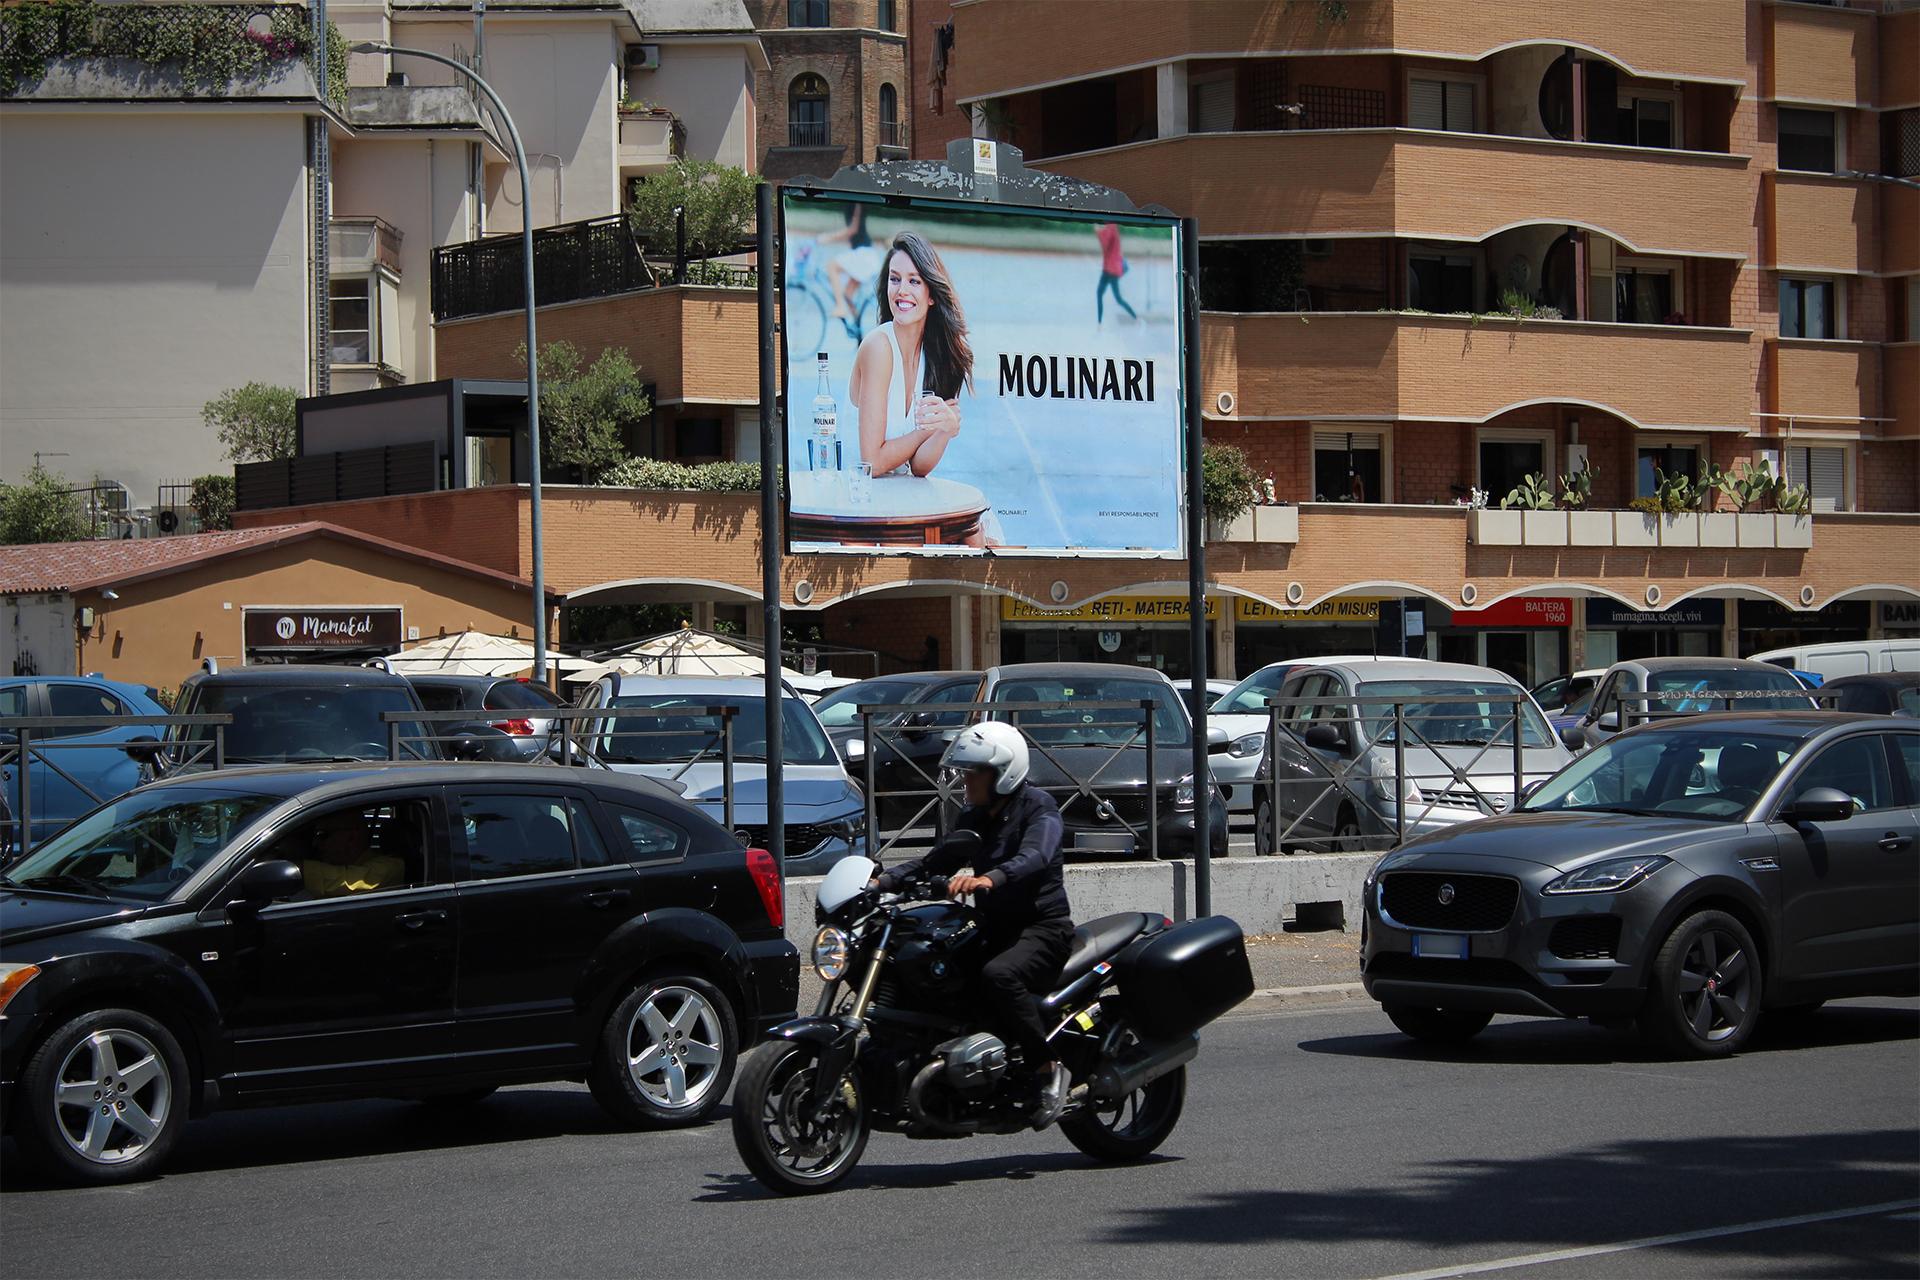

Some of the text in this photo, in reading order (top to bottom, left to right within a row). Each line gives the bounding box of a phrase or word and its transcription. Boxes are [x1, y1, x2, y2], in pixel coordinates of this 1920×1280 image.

[999, 353, 1155, 402] MOLINARI
[1092, 601, 1123, 615] RETI
[1135, 601, 1214, 615] MATERASI
[1525, 602, 1565, 612] BALTERA
[1884, 604, 1920, 622] BAN
[1544, 612, 1566, 622] 1960
[1612, 611, 1702, 623] immagina, scegli, vivi
[303, 615, 373, 639] MamaEat
